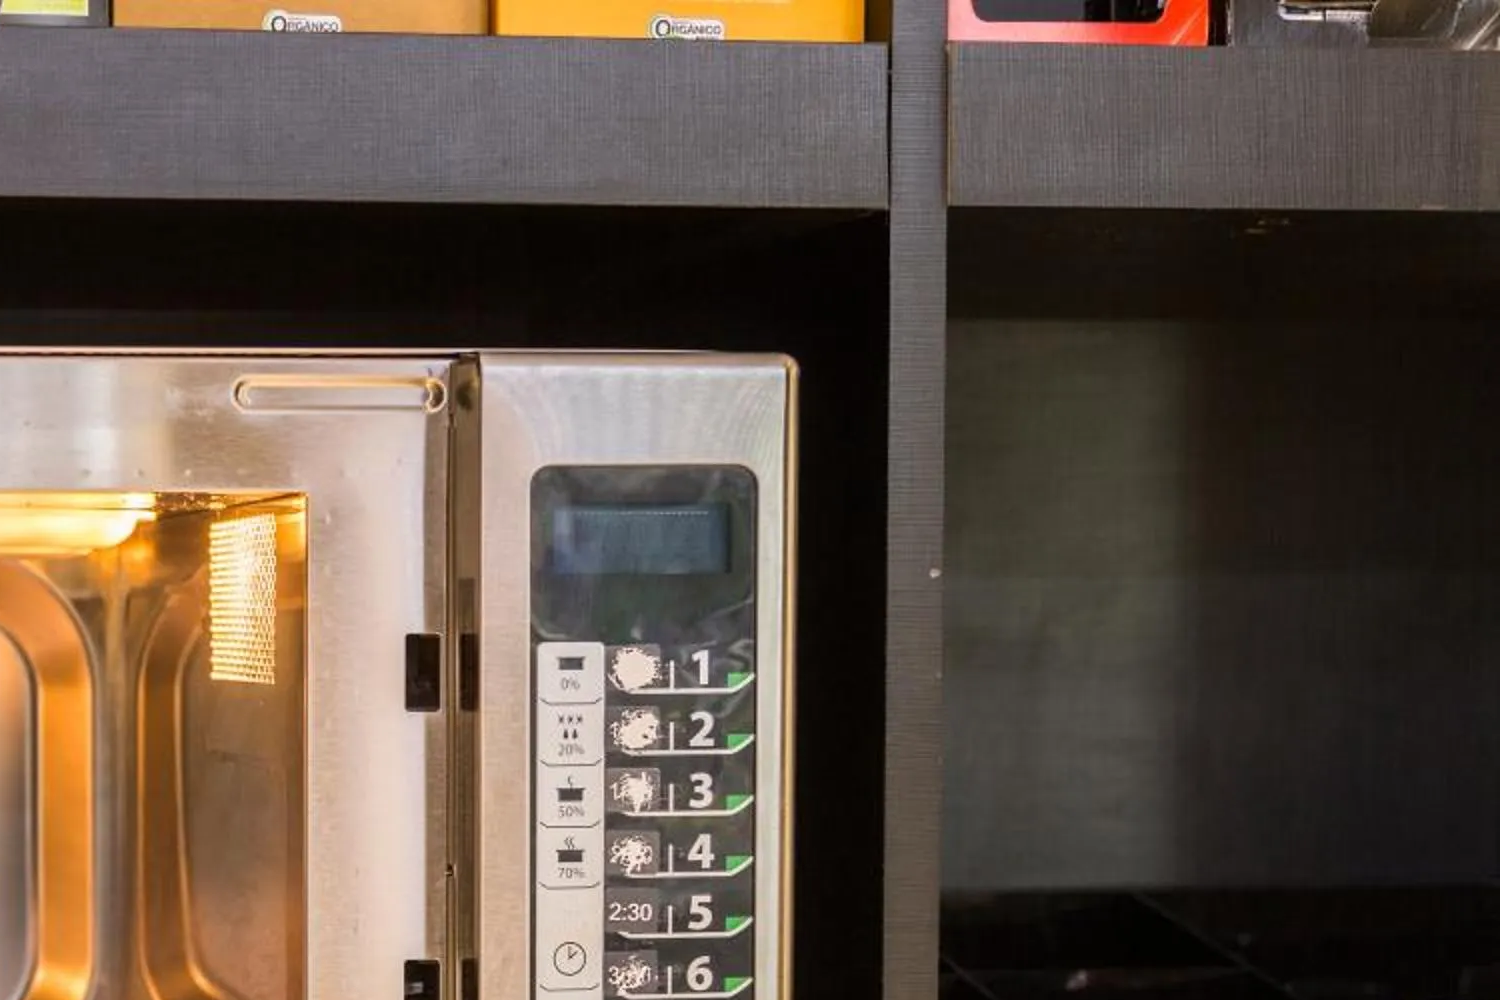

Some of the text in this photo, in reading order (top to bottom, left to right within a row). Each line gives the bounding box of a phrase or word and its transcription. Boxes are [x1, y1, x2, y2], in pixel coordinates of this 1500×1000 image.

[560, 677, 581, 691] 0%
[691, 649, 710, 686] 1
[688, 711, 715, 748] 2
[557, 744, 585, 758] 20%
[688, 773, 713, 809] 3
[557, 805, 585, 818] 50%
[687, 833, 715, 870] 4
[557, 867, 586, 880] 70%
[608, 903, 653, 923] 2:30
[687, 895, 714, 931] 5
[686, 955, 714, 992] 6
